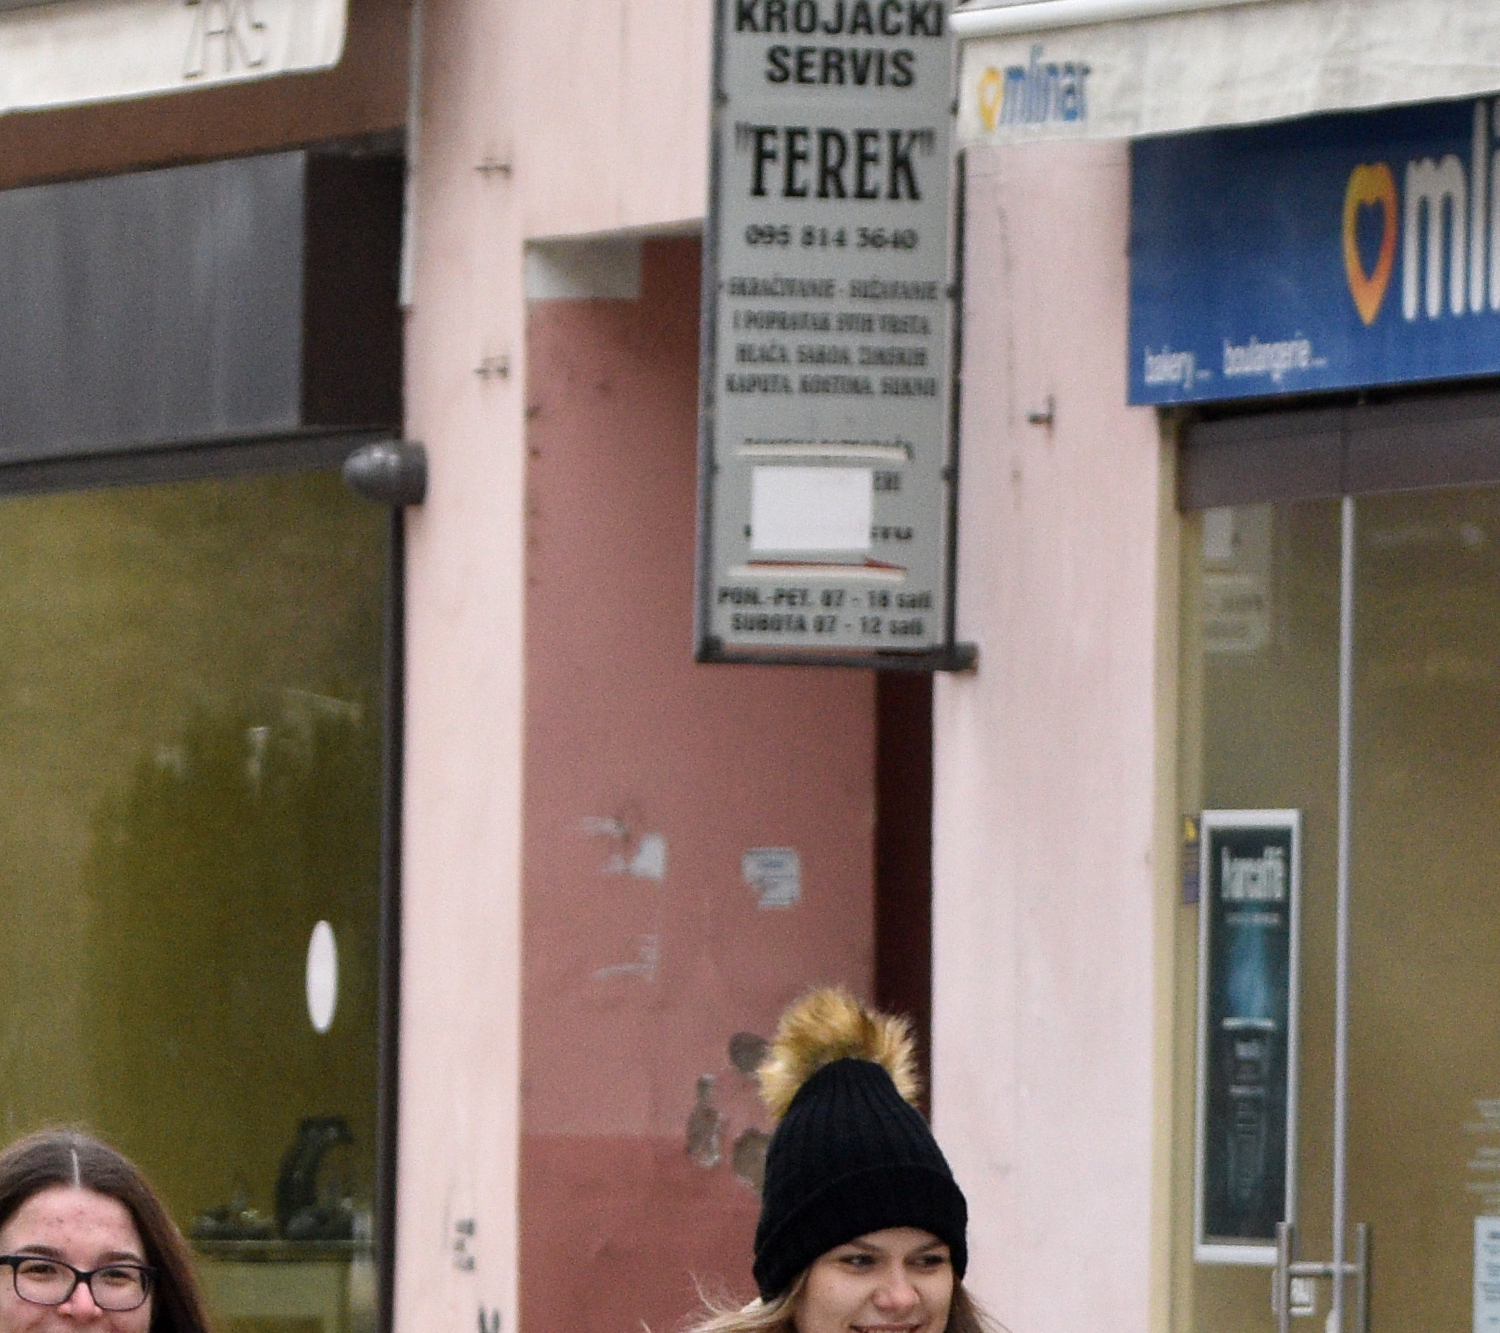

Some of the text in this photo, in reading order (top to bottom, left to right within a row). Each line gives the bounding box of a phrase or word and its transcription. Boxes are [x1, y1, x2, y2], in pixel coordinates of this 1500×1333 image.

[766, 44, 916, 87] SERVIS
[1000, 44, 1092, 126] mlinar
[801, 225, 847, 248] 814
